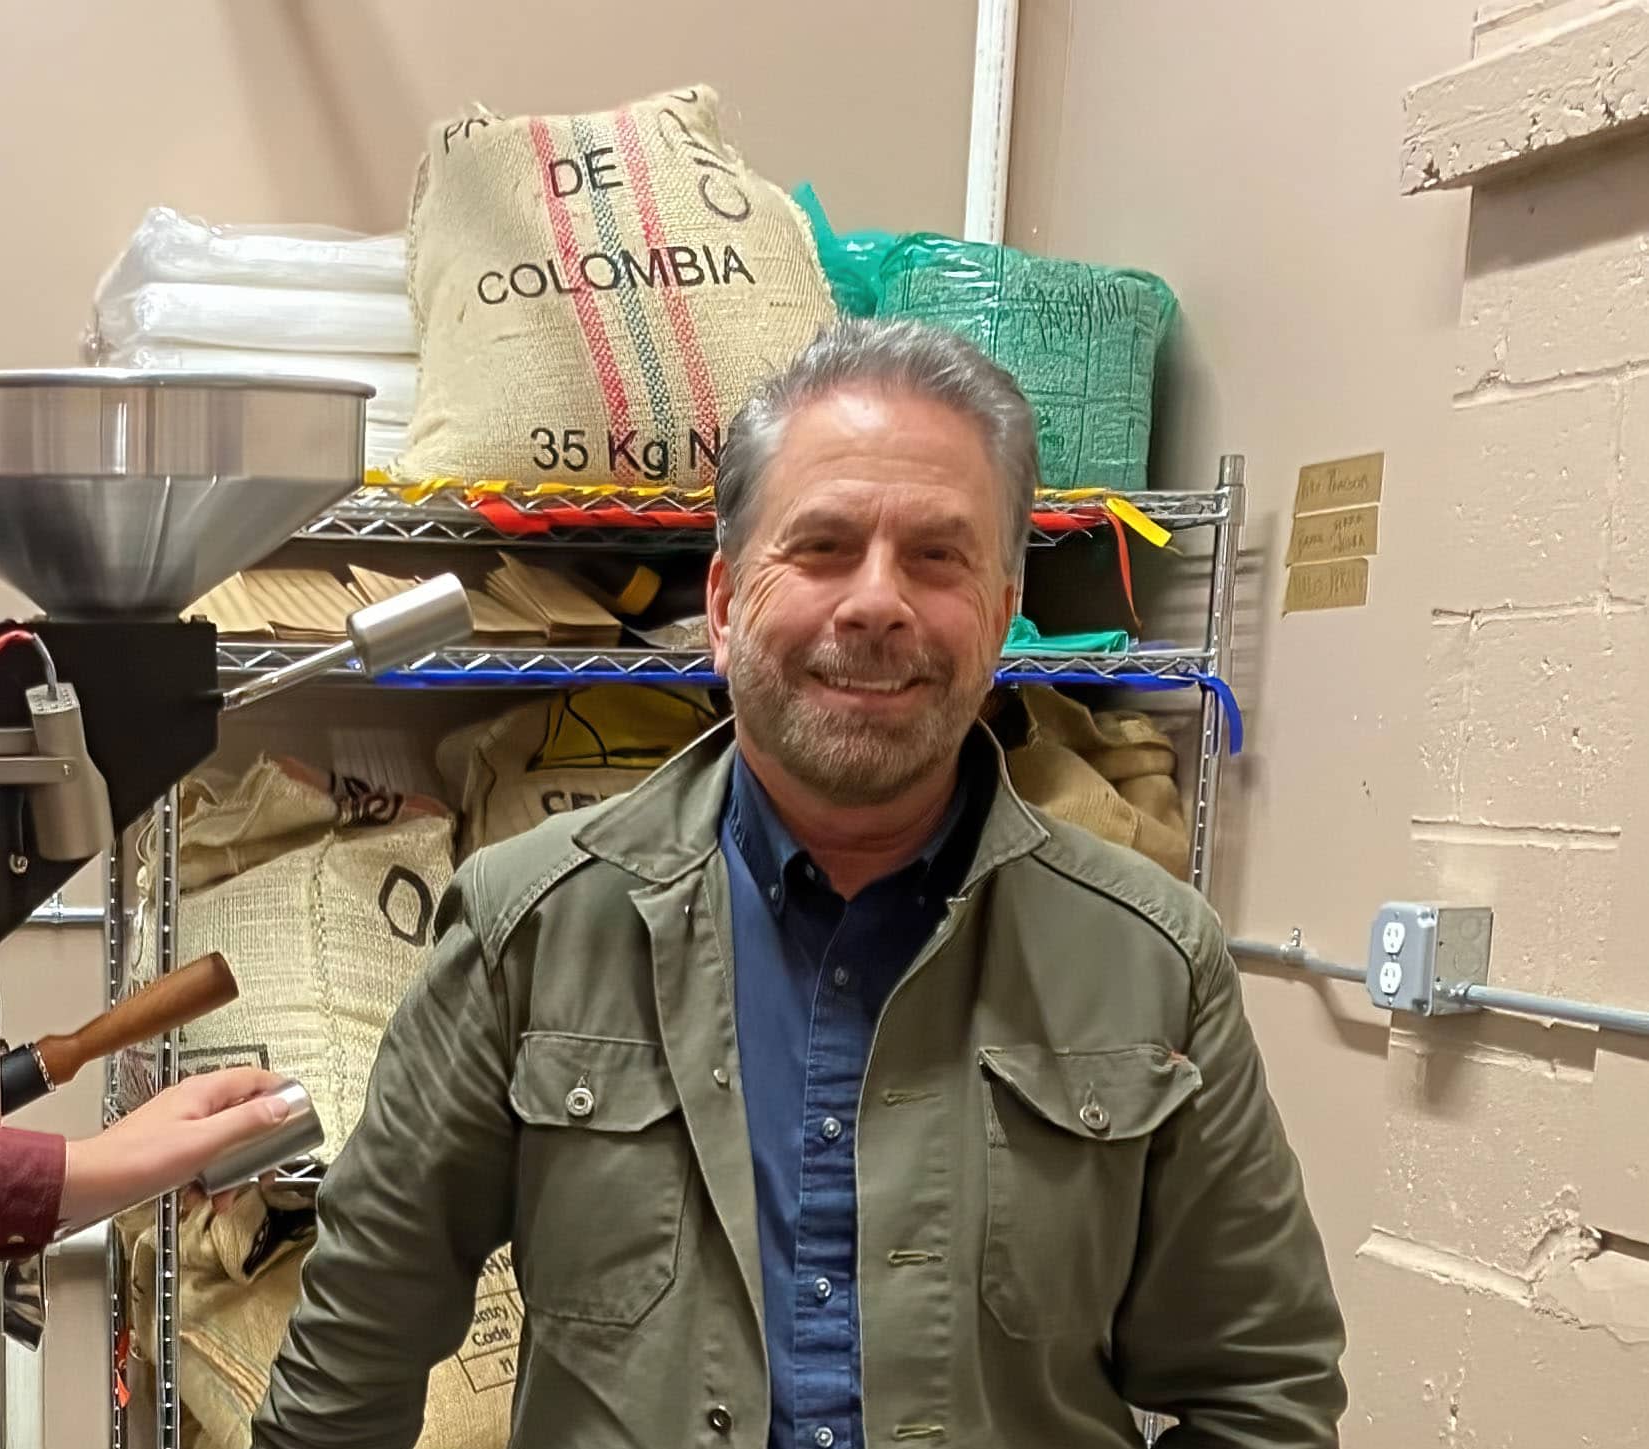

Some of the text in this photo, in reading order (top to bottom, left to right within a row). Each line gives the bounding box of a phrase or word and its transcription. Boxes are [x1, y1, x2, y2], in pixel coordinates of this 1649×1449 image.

[549, 146, 624, 198] DE
[477, 245, 756, 305] COLOMBIA
[530, 427, 589, 472] 35
[607, 429, 670, 481] Kg
[471, 1326, 512, 1347] Code
